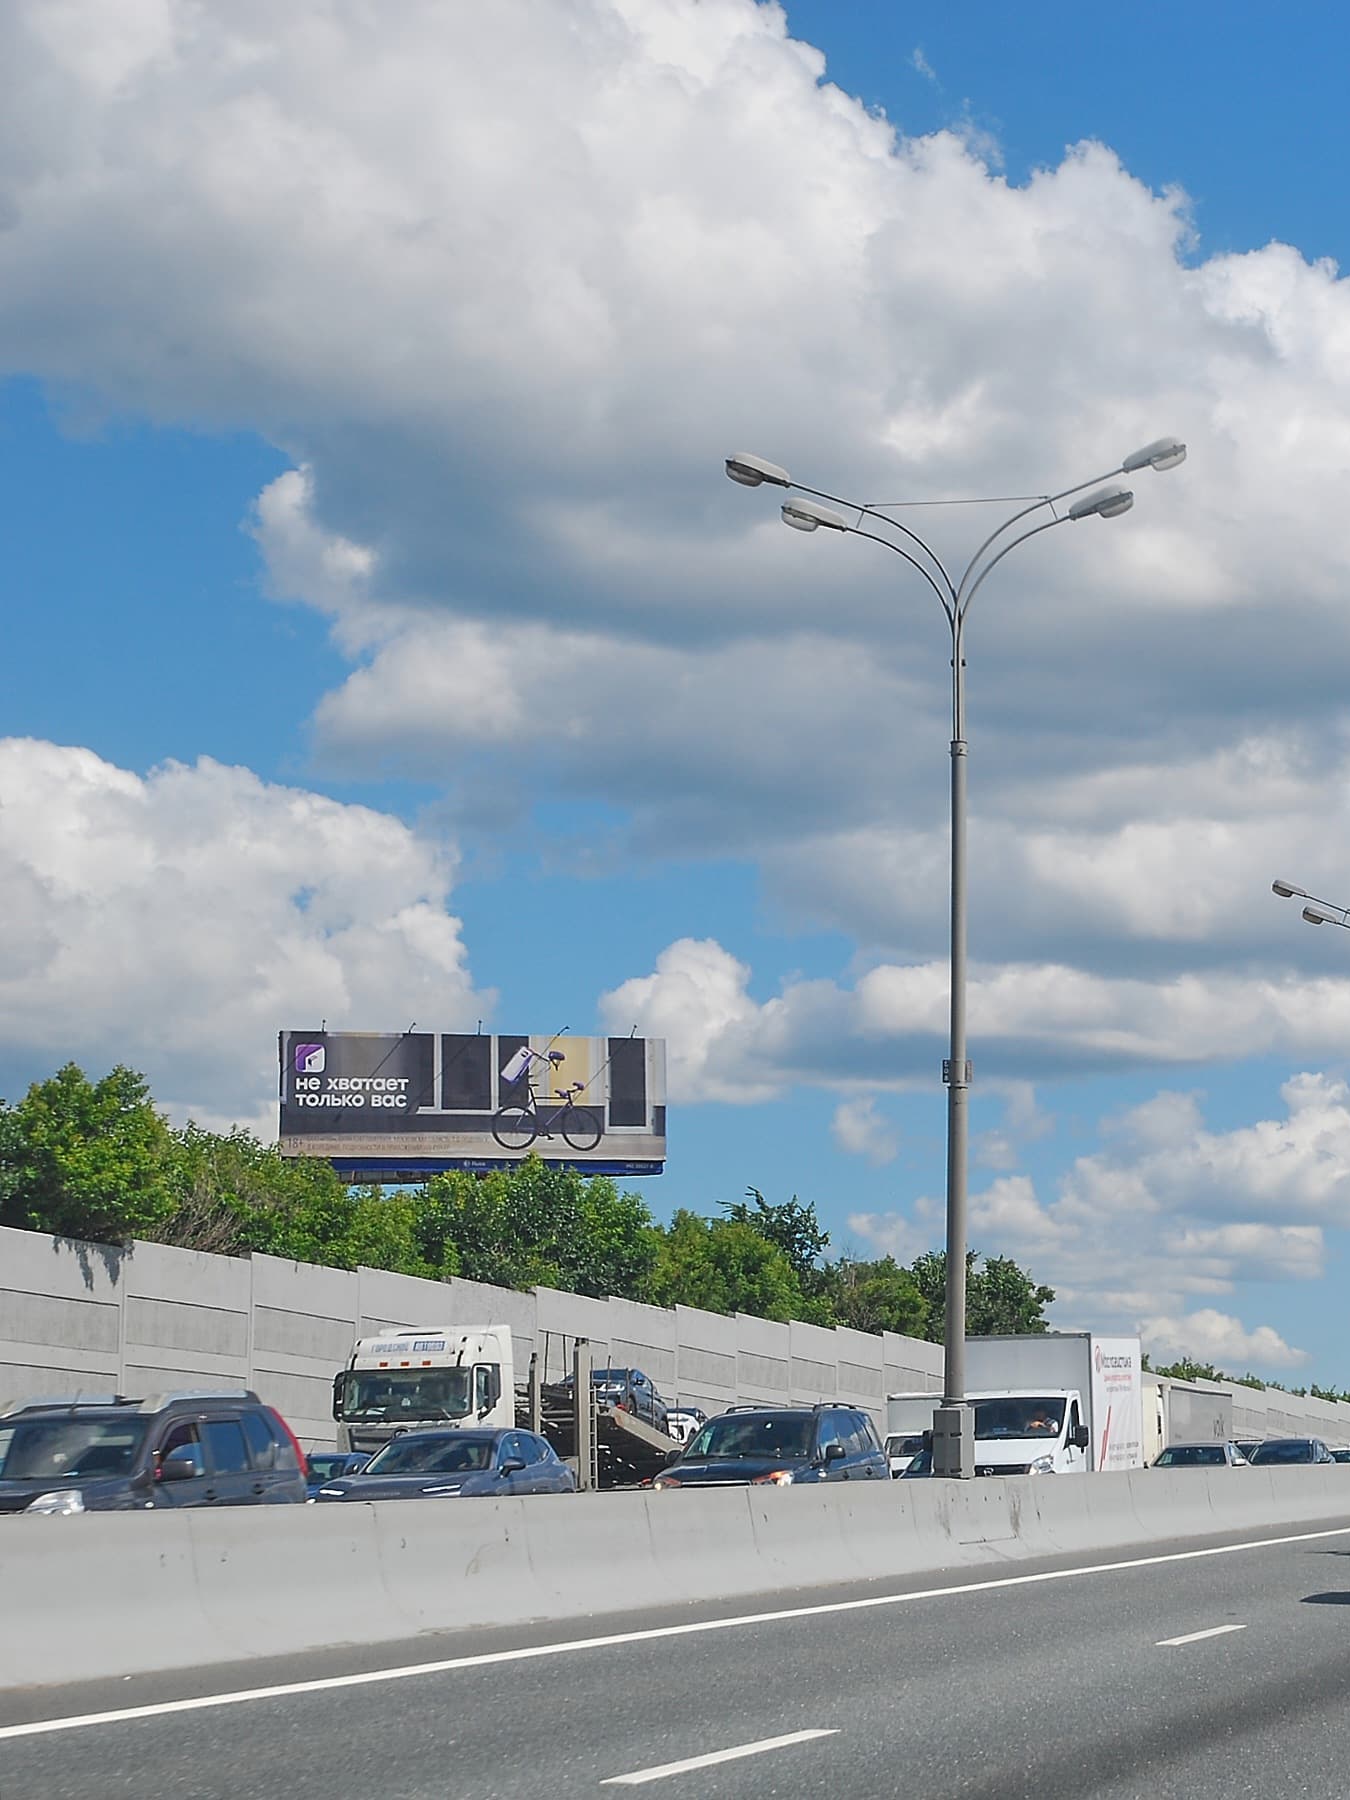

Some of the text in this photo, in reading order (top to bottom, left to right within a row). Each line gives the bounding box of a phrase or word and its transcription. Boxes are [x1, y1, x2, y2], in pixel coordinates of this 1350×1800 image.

[295, 1077, 409, 1091] не хватает
[295, 1094, 407, 1107] только вас
[287, 1138, 303, 1149] 18+
